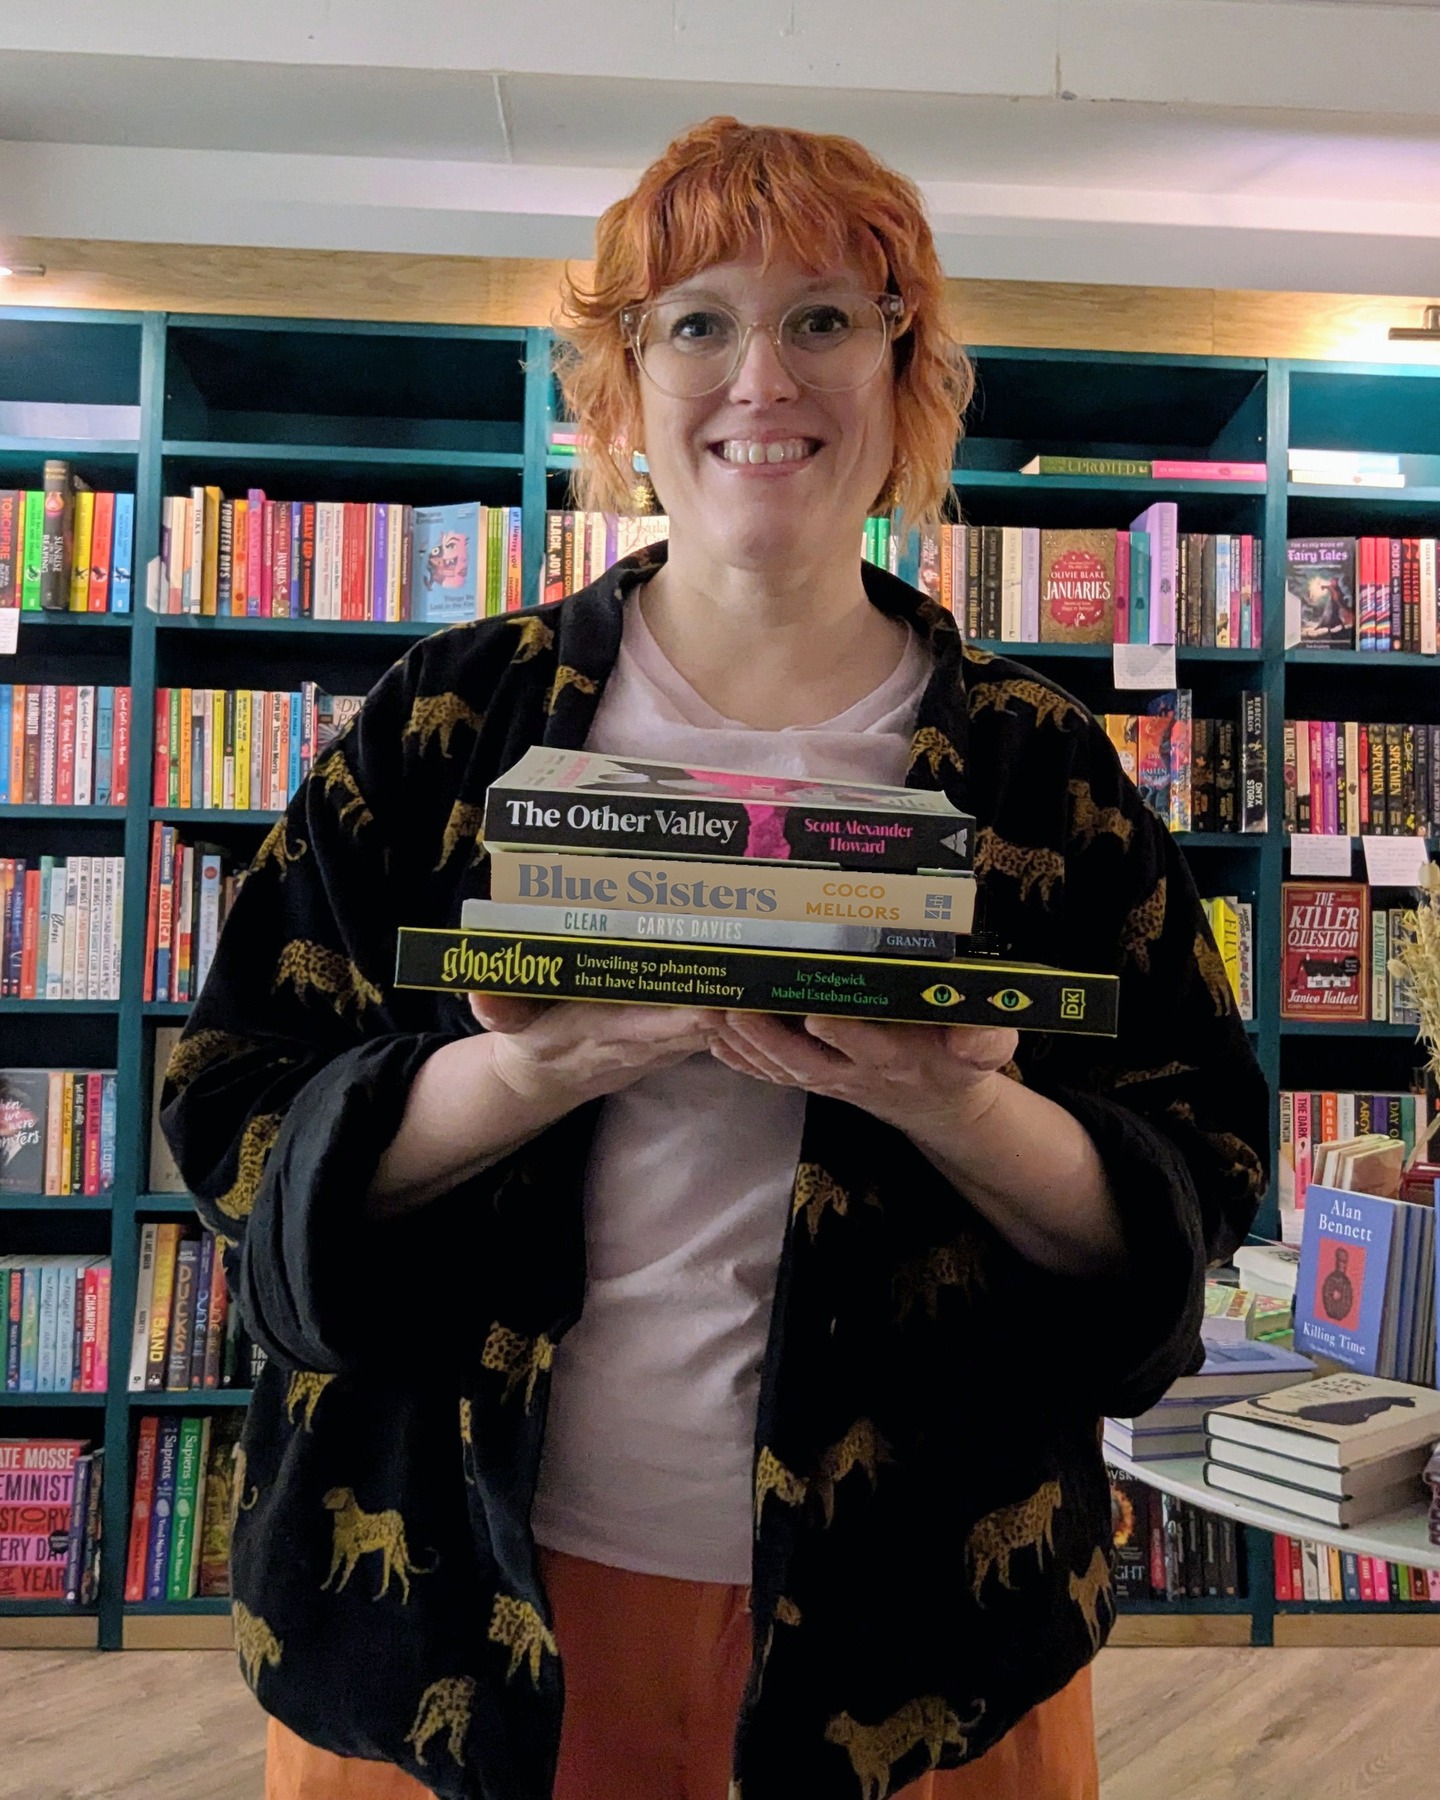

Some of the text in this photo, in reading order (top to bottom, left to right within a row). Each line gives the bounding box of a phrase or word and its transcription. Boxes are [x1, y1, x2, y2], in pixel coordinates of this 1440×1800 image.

[1287, 549, 1348, 563] Fairy Tales
[1050, 571, 1105, 579] OLIVIE BLAKE
[1043, 580, 1111, 601] JANUARIES
[1372, 744, 1384, 796] SPECIMEN
[1389, 744, 1402, 797] SPECIMEN
[1246, 779, 1256, 809] STORM
[1254, 781, 1263, 806] ONYX
[506, 800, 739, 844] The Other Valley
[804, 818, 913, 838] Scott Alexander
[829, 837, 885, 855] Howard
[518, 864, 778, 913] Blue Sisters
[823, 883, 885, 899] COCO
[1315, 892, 1336, 907] THE
[564, 911, 608, 932] CLEAR
[806, 902, 901, 921] MELLORS
[1288, 905, 1361, 930] KILLER
[637, 916, 743, 941] CARYS DAVIES
[1287, 929, 1360, 949] QUESTION
[886, 935, 937, 949] GRANTA
[1224, 918, 1237, 965] FLUX
[440, 937, 564, 987] ghostlore
[576, 953, 727, 977] Unveiling 50 phantoms
[574, 973, 745, 1000] that have haunted history
[796, 970, 867, 987] Icy Sedgwick
[771, 987, 806, 1000] Mabel
[807, 988, 851, 1002] Esteban
[1065, 994, 1080, 1016] DK
[1287, 989, 1360, 1005] Janice Hallett
[1297, 1097, 1308, 1139] THE DARK
[1359, 1101, 1371, 1134] ARGY
[1389, 1101, 1399, 1125] DAY
[1330, 1200, 1362, 1222] Alan
[1318, 1213, 1373, 1242] Bennett
[83, 1294, 97, 1343] CHAMPIONS
[172, 1264, 193, 1353] DUCKS
[149, 1317, 168, 1363] SAND
[1303, 1321, 1336, 1347] Killing
[1339, 1334, 1367, 1355] Time
[24, 1447, 75, 1469] MOSSE
[140, 1437, 156, 1481] Sapiens
[160, 1435, 178, 1480] Sapiens
[181, 1435, 197, 1479] Sapiens
[21, 1566, 65, 1592] YEAR
